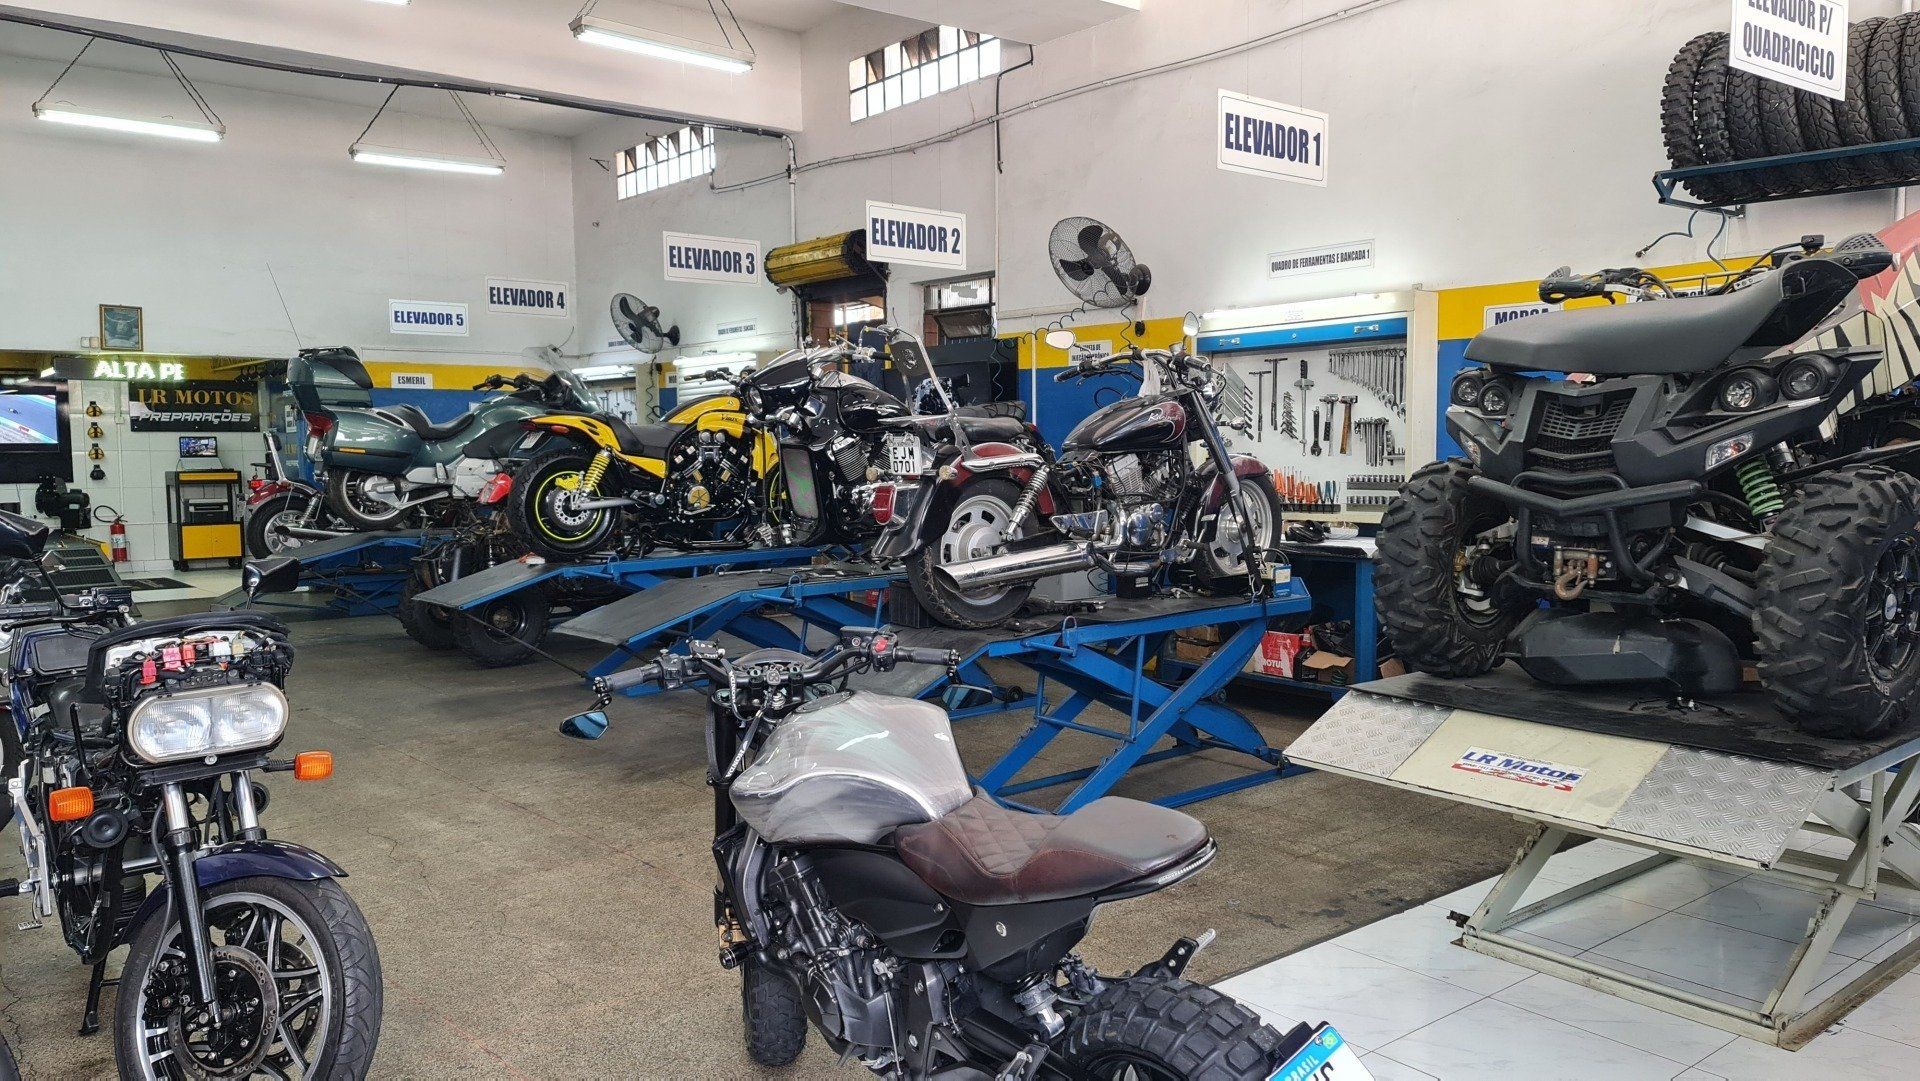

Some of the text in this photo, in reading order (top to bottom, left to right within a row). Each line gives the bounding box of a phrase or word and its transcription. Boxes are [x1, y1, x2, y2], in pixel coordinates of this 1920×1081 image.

[1748, 0, 1833, 36] VADOR P/
[1743, 21, 1835, 81] QUADRICICLO
[1225, 112, 1321, 166] ELEVADOR 1
[871, 217, 961, 255] ELEVADOR 2
[669, 245, 756, 275] ELEVADOR 3
[1271, 259, 1292, 273] QUADRO
[1292, 258, 1299, 269] DE
[1299, 253, 1336, 268] FERRAMENTAS
[1340, 249, 1366, 263] BANCADA
[489, 286, 565, 310] ELEVADOR 4
[393, 310, 464, 327] ELEVADOR 5
[93, 360, 156, 380] ALTA
[397, 375, 427, 386] ESMERIL
[137, 388, 254, 406] LR MOTOS
[138, 409, 252, 425] PREPARAÇÕES
[892, 460, 916, 473] 0701
[1461, 751, 1499, 765] LR
